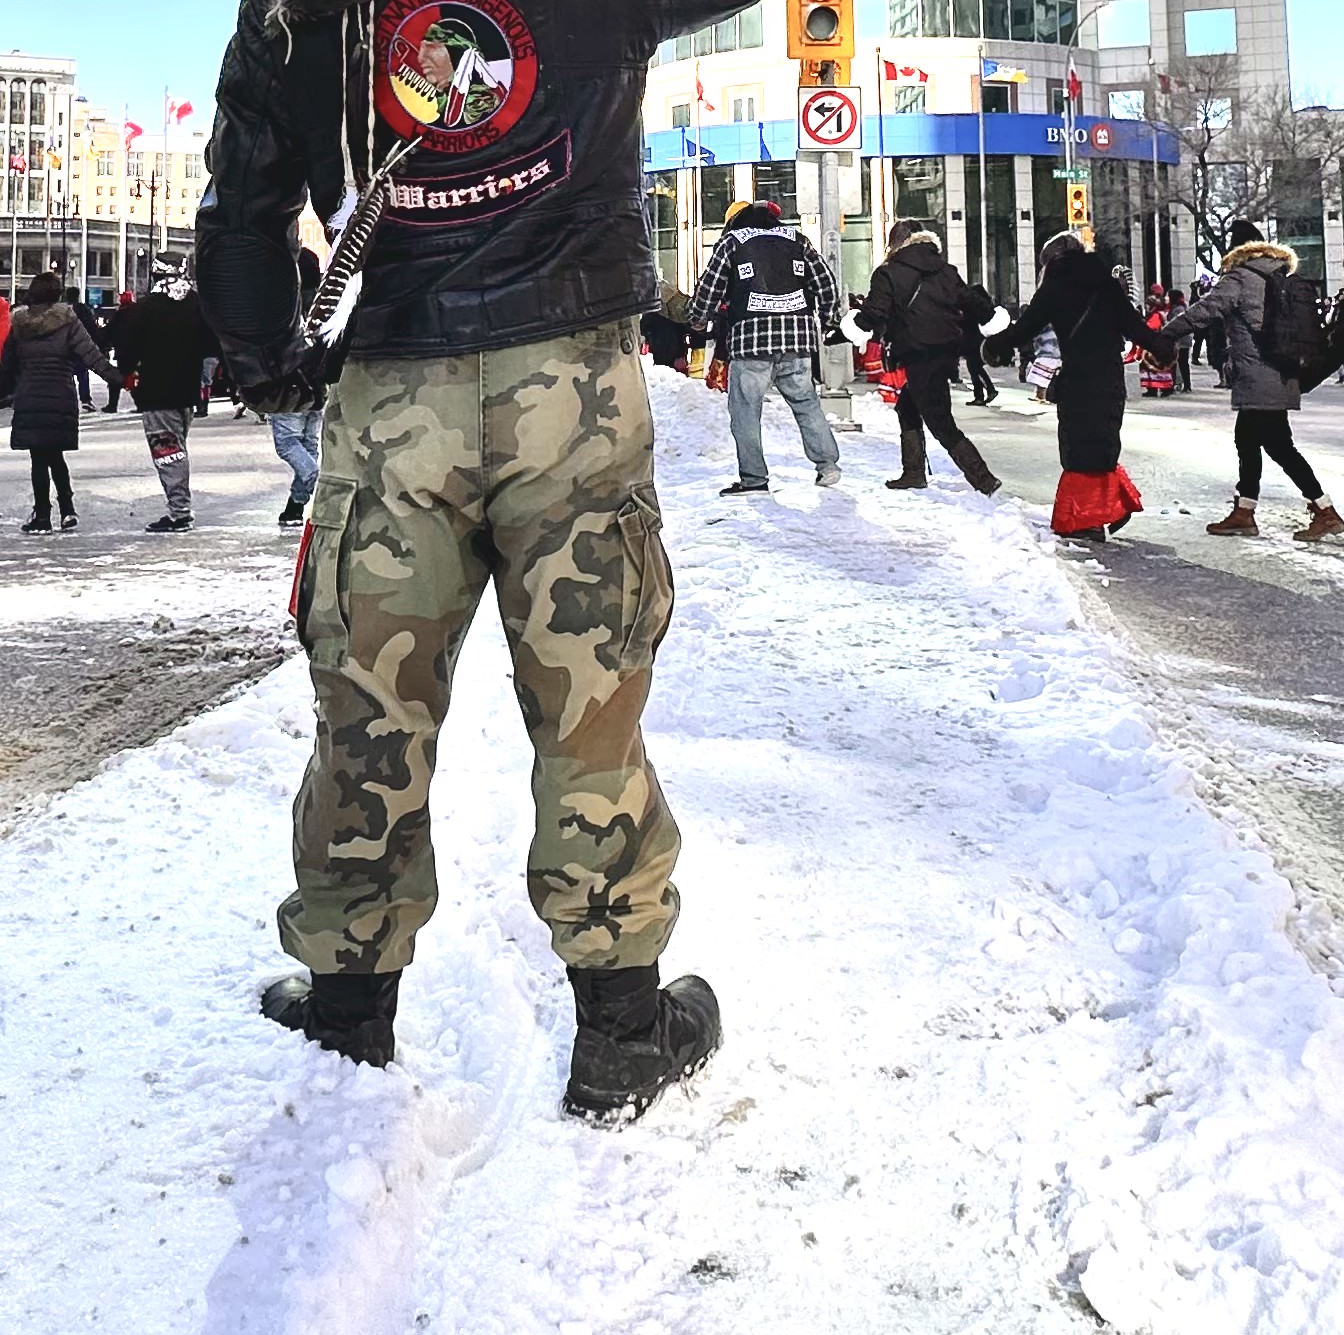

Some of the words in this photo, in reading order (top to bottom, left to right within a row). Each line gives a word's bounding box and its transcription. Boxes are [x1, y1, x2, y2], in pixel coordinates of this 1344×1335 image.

[384, 159, 553, 209] Warriors
[1052, 169, 1075, 179] Main
[1078, 169, 1089, 179] St
